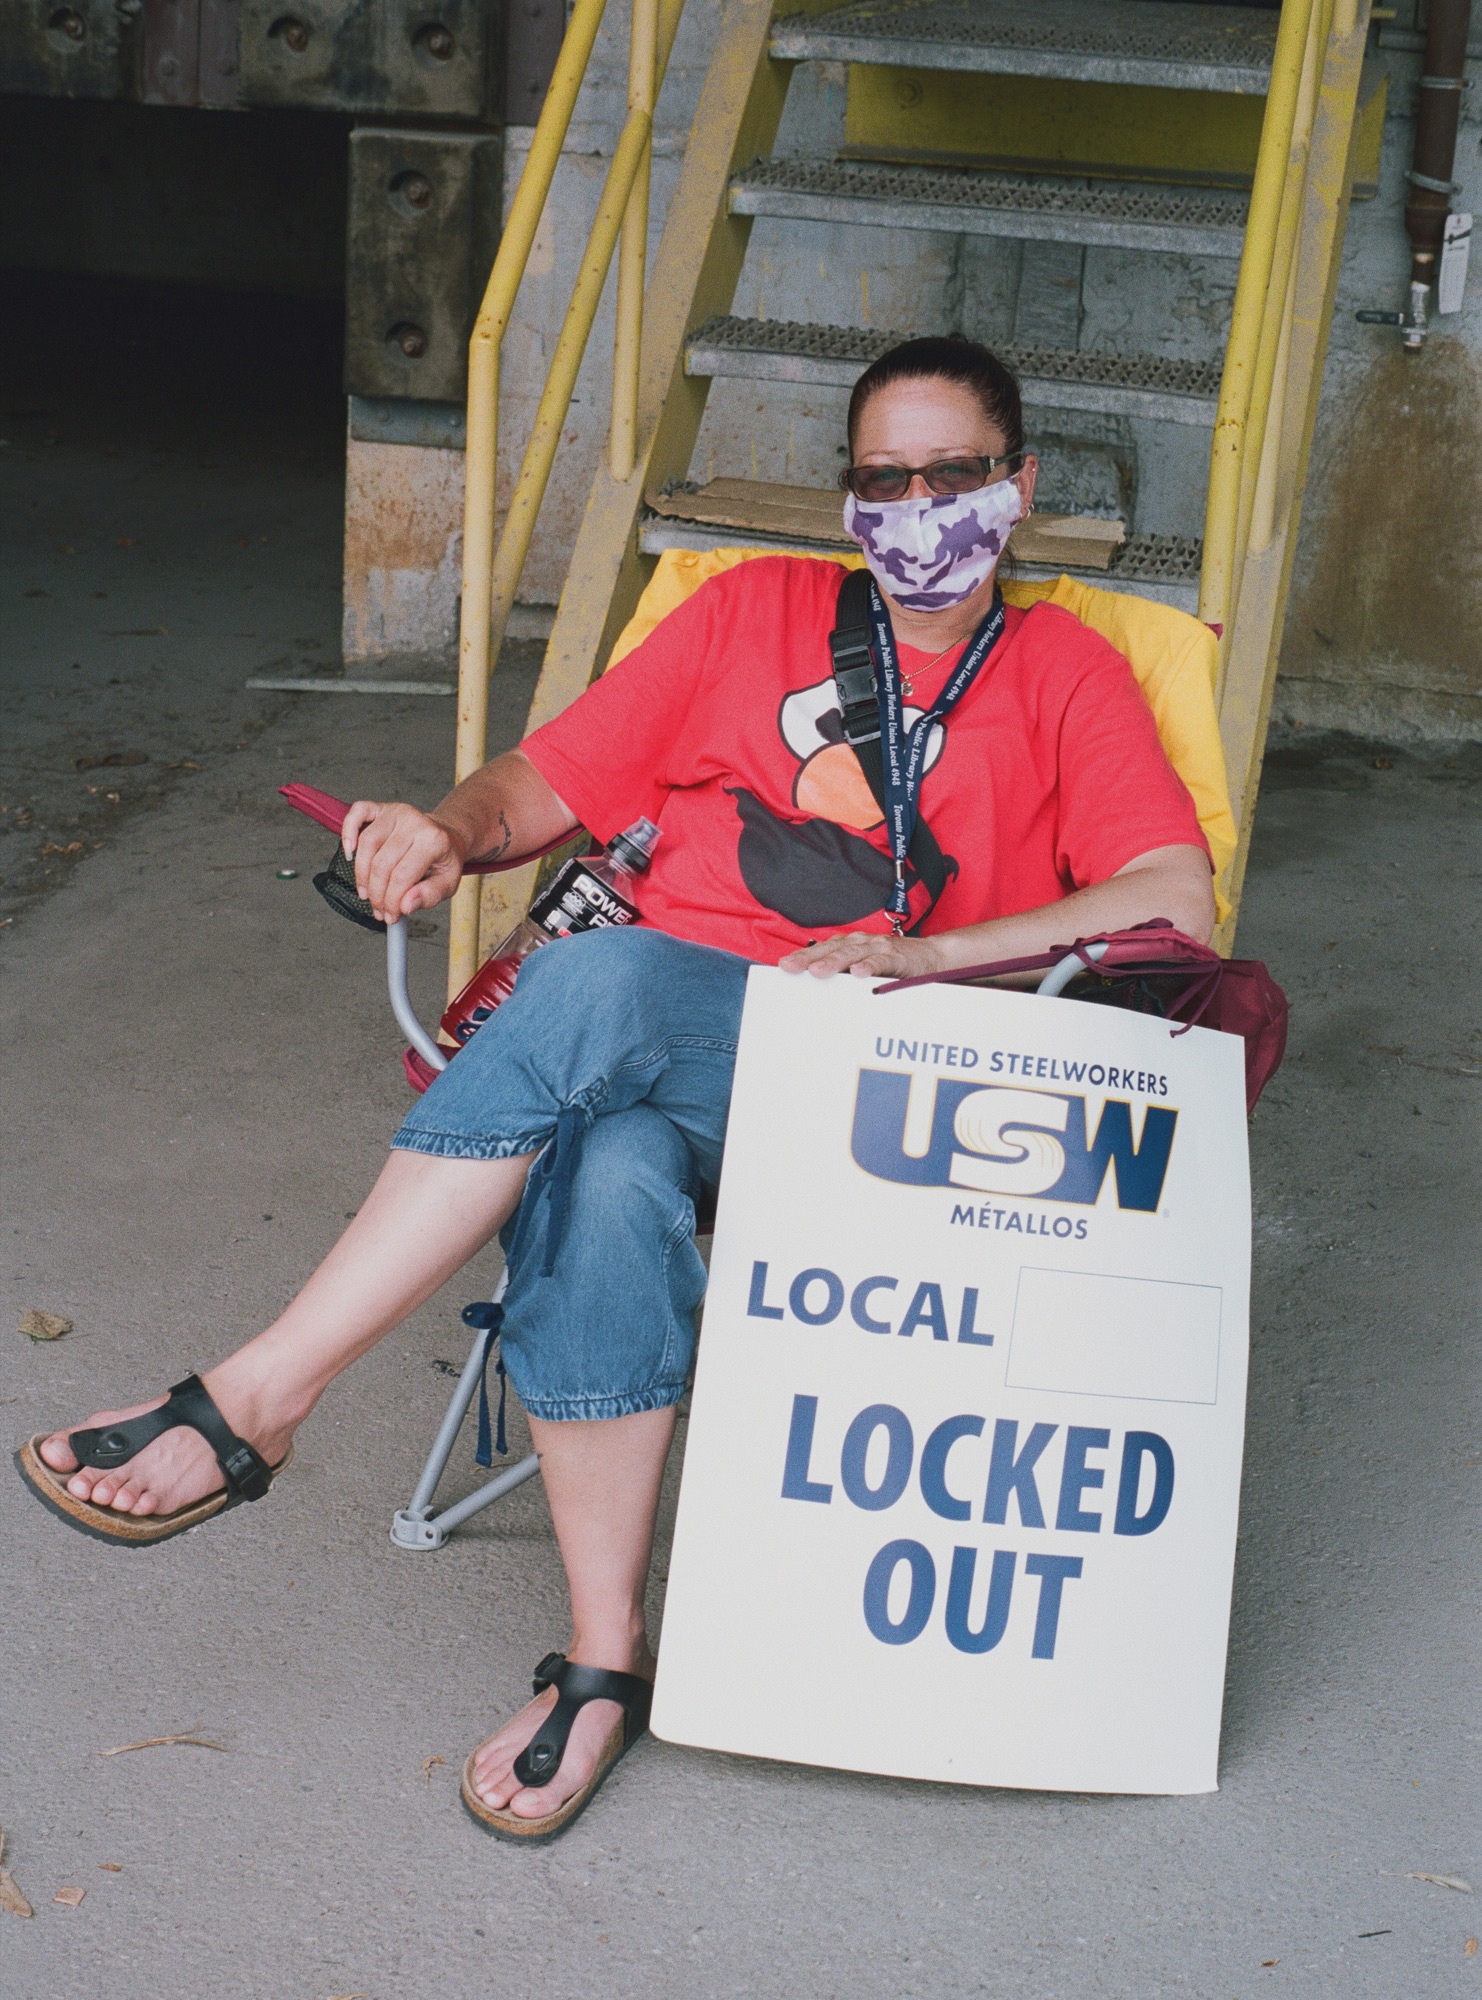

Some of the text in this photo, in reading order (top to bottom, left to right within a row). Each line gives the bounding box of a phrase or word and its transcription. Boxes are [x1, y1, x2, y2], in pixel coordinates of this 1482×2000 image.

[987, 611, 1004, 631] Library
[965, 650, 982, 670] Union
[955, 669, 971, 687] Local
[877, 622, 901, 786] Toronto Public Library Workers Union Local 4948
[913, 722, 928, 747] Public
[905, 747, 921, 780] Library
[893, 804, 904, 833] Toronto
[895, 833, 906, 858] Public
[875, 1036, 1169, 1096] UNITED STEELWORKERS
[849, 1065, 1180, 1215] USW
[950, 1202, 1089, 1240] MÉTALLOS
[747, 1260, 995, 1347] LOCAL
[781, 1393, 1175, 1537] LOCKED
[863, 1538, 1084, 1660] OUT
